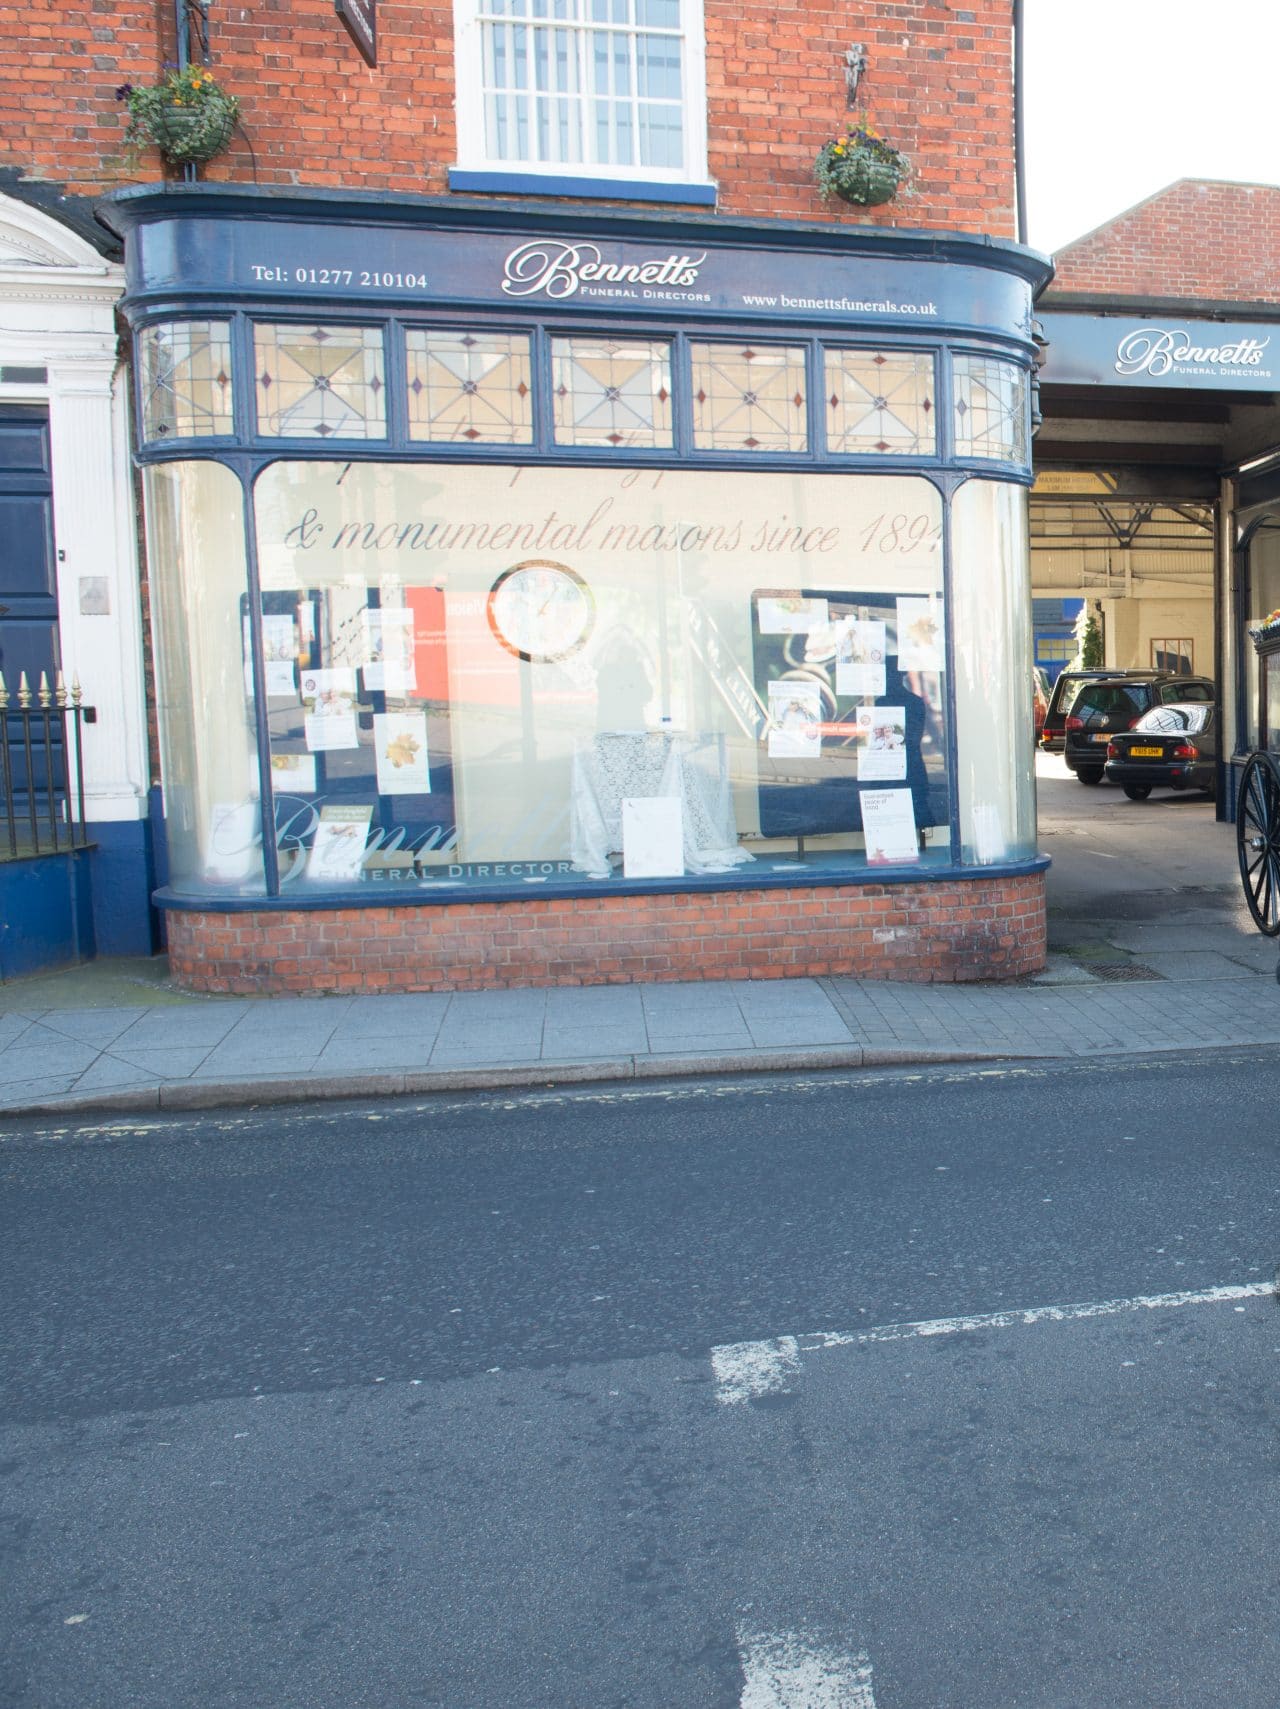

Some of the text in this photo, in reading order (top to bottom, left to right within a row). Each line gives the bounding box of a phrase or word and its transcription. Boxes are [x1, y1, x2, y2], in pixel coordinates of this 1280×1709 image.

[251, 265, 428, 289] Tel: 01277 210104
[501, 240, 708, 299] Bennetts
[580, 286, 712, 302] FUNERAL DIRECTORS
[1115, 328, 1271, 377] Bennetts
[1173, 365, 1272, 379] FUNERAL DIRECTORS
[284, 508, 324, 550] &
[331, 496, 614, 551] monumental
[598, 519, 743, 553] masons
[750, 514, 840, 553] since
